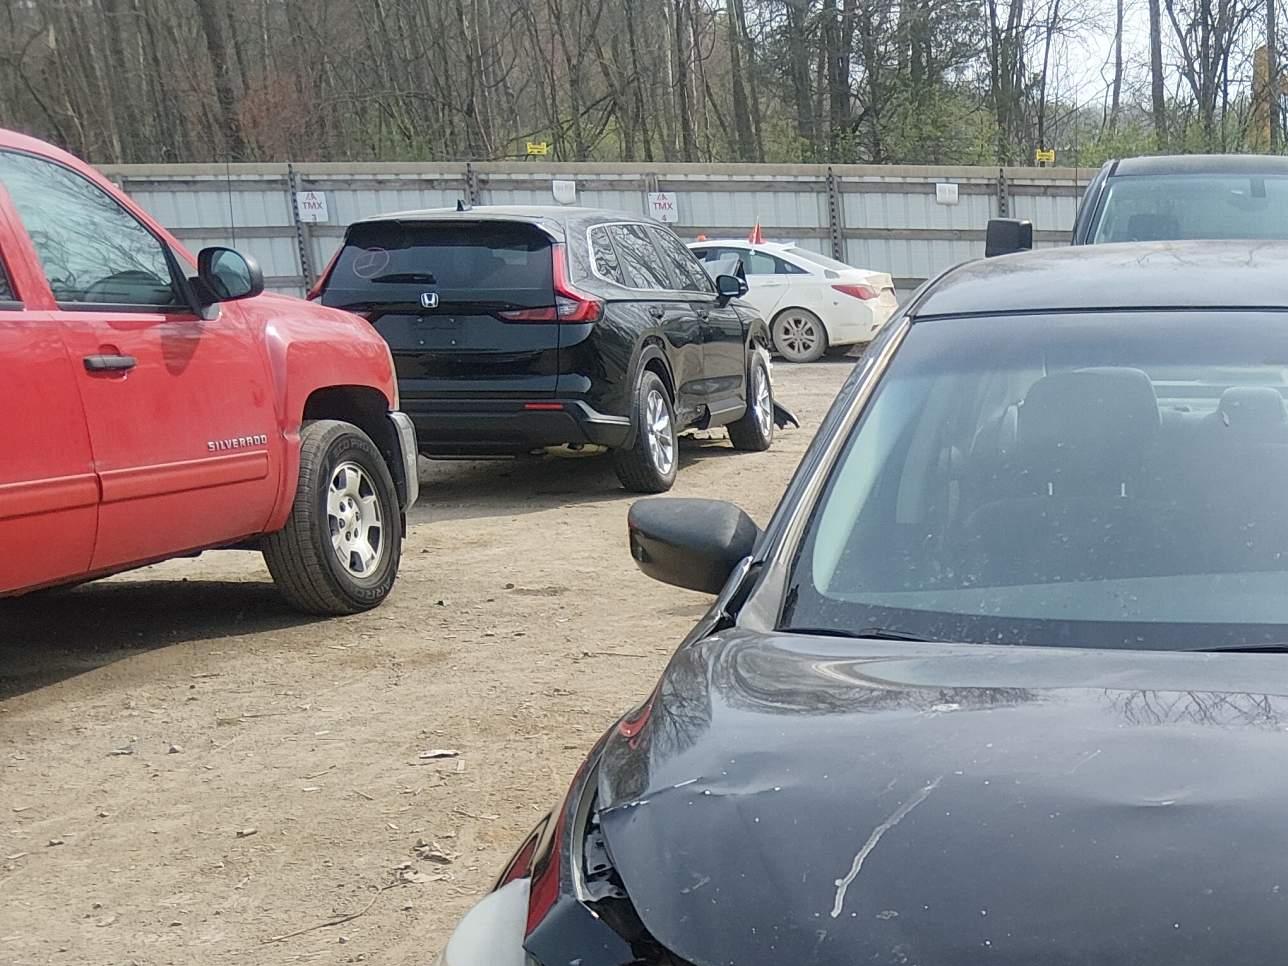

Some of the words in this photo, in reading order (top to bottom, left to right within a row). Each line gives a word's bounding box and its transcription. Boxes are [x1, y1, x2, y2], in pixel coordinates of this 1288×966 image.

[303, 201, 324, 210] TMX
[653, 202, 674, 210] TMX
[207, 434, 268, 452] SILVERADO
